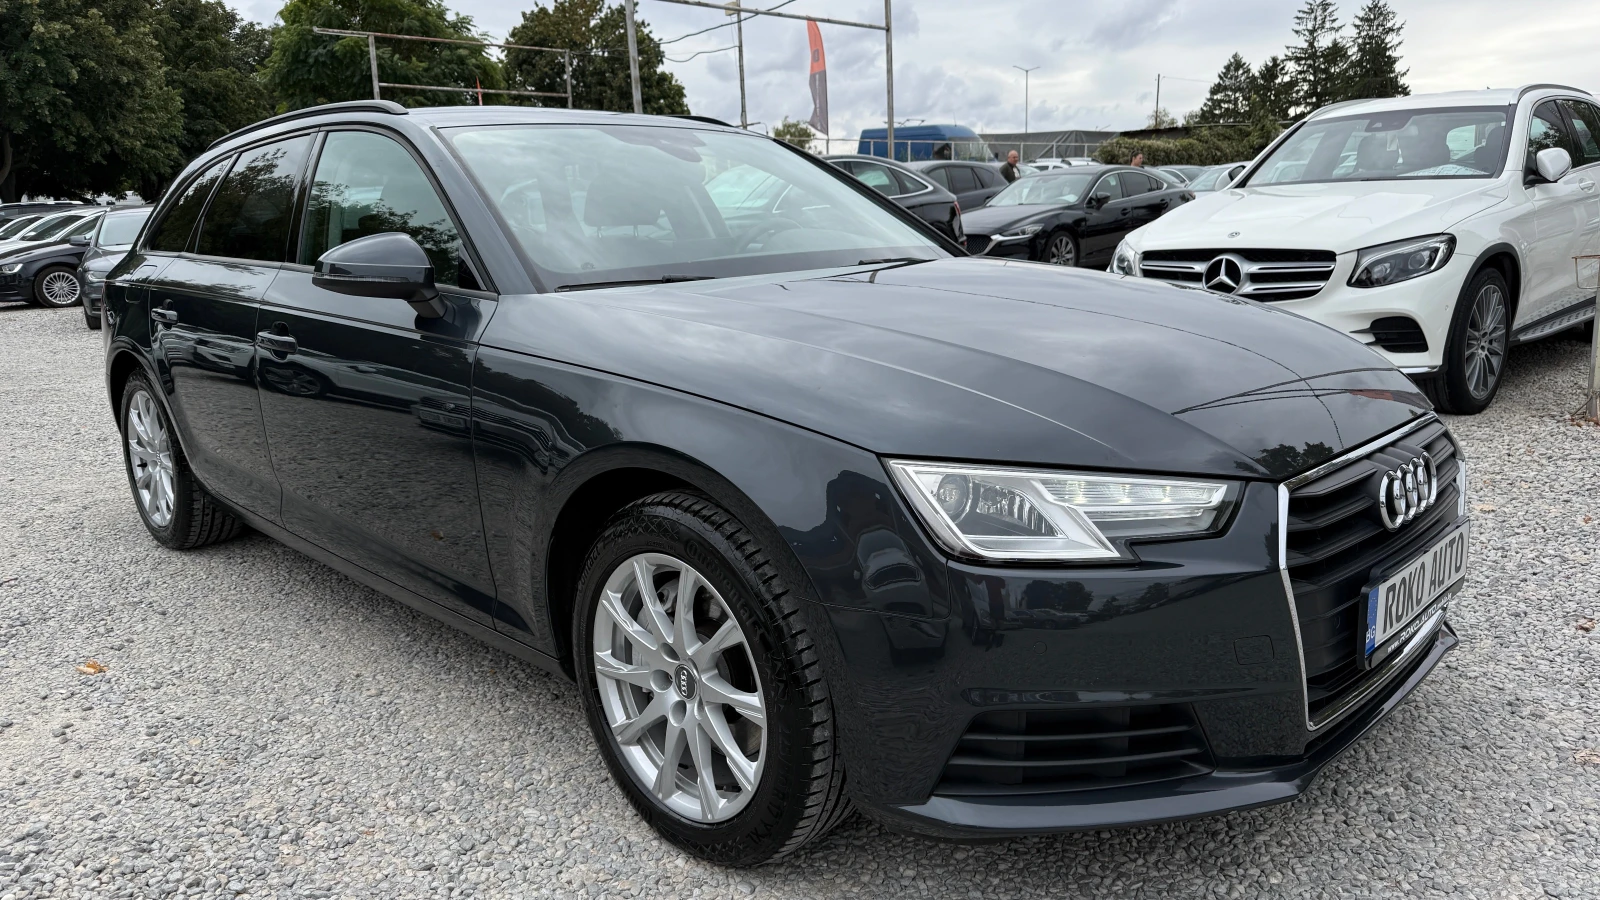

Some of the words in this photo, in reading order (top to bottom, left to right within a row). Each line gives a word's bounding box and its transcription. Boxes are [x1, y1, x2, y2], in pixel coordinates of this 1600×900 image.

[1383, 561, 1425, 635] ROKO
[1428, 531, 1465, 597] AUTO
[1365, 625, 1376, 644] BG
